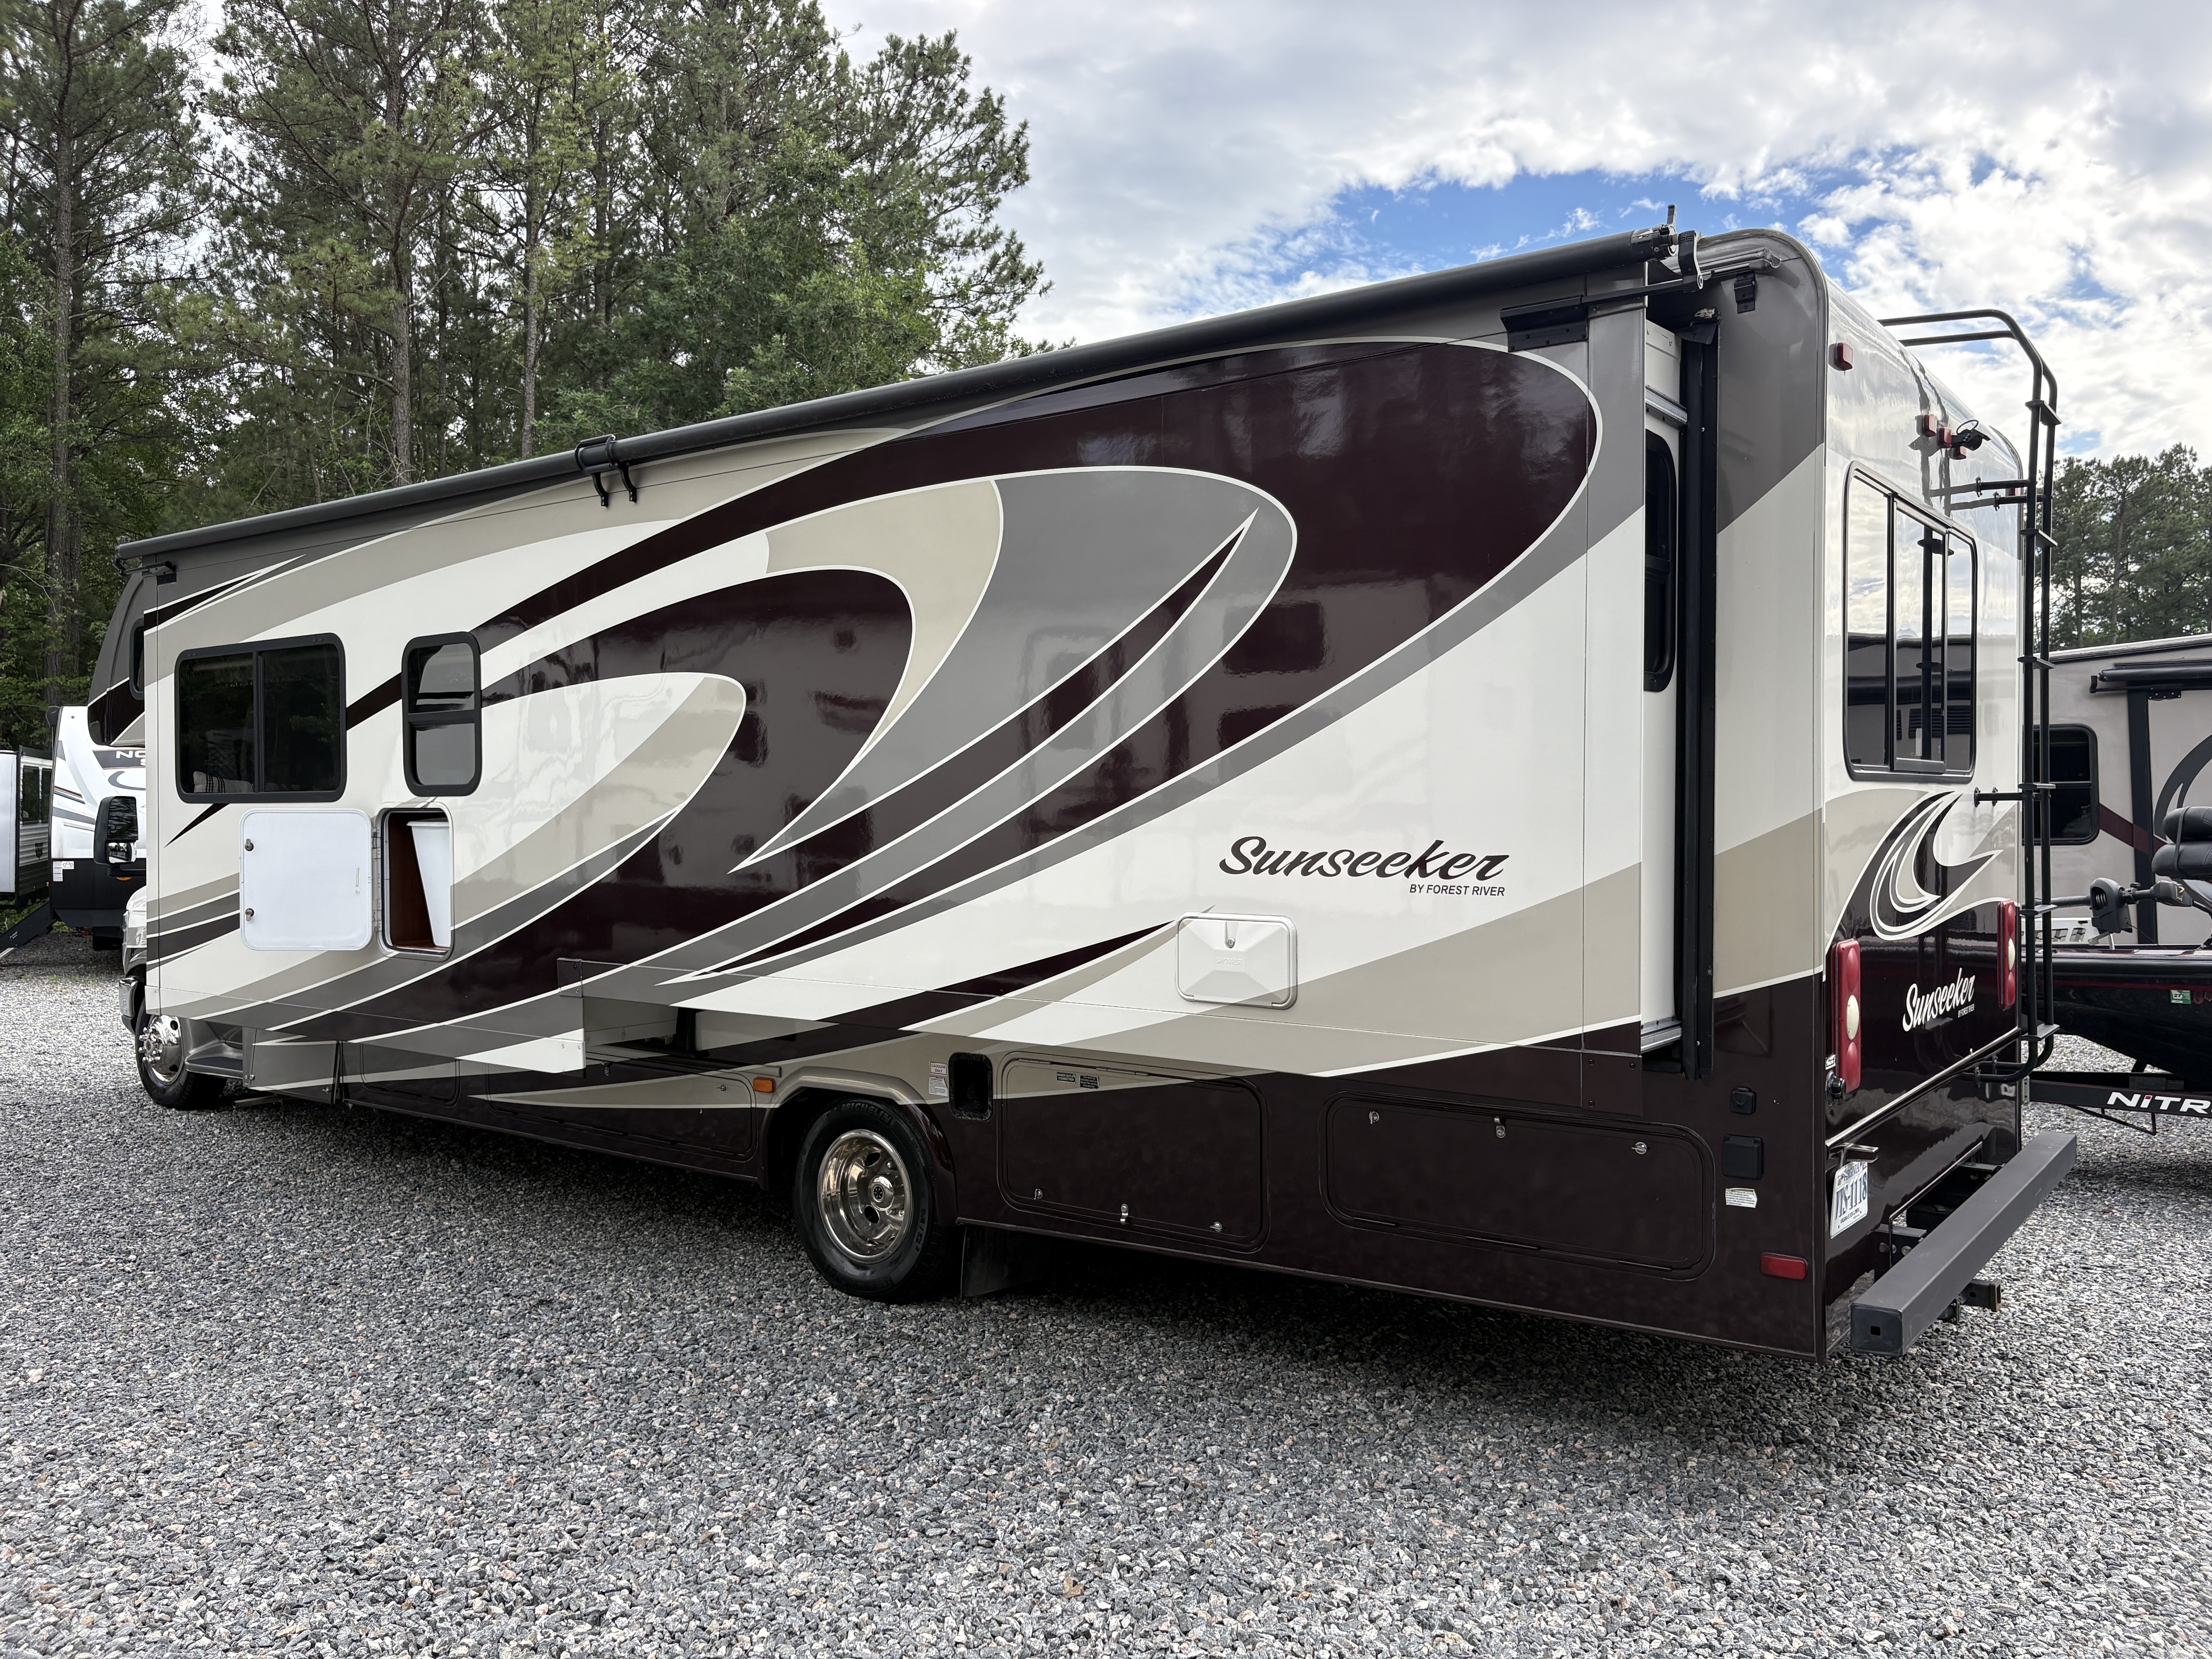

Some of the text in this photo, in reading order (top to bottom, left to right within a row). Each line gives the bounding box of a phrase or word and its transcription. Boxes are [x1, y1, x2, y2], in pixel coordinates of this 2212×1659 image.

[1219, 836, 1510, 882] Sunseeker
[1410, 884, 1505, 896] BY FOREST RIVER
[1215, 957, 1242, 965] SHOWER
[1902, 967, 1975, 1032] Sunseeker
[841, 1102, 893, 1127] MICHELIN
[2107, 1092, 2212, 1115] NITR
